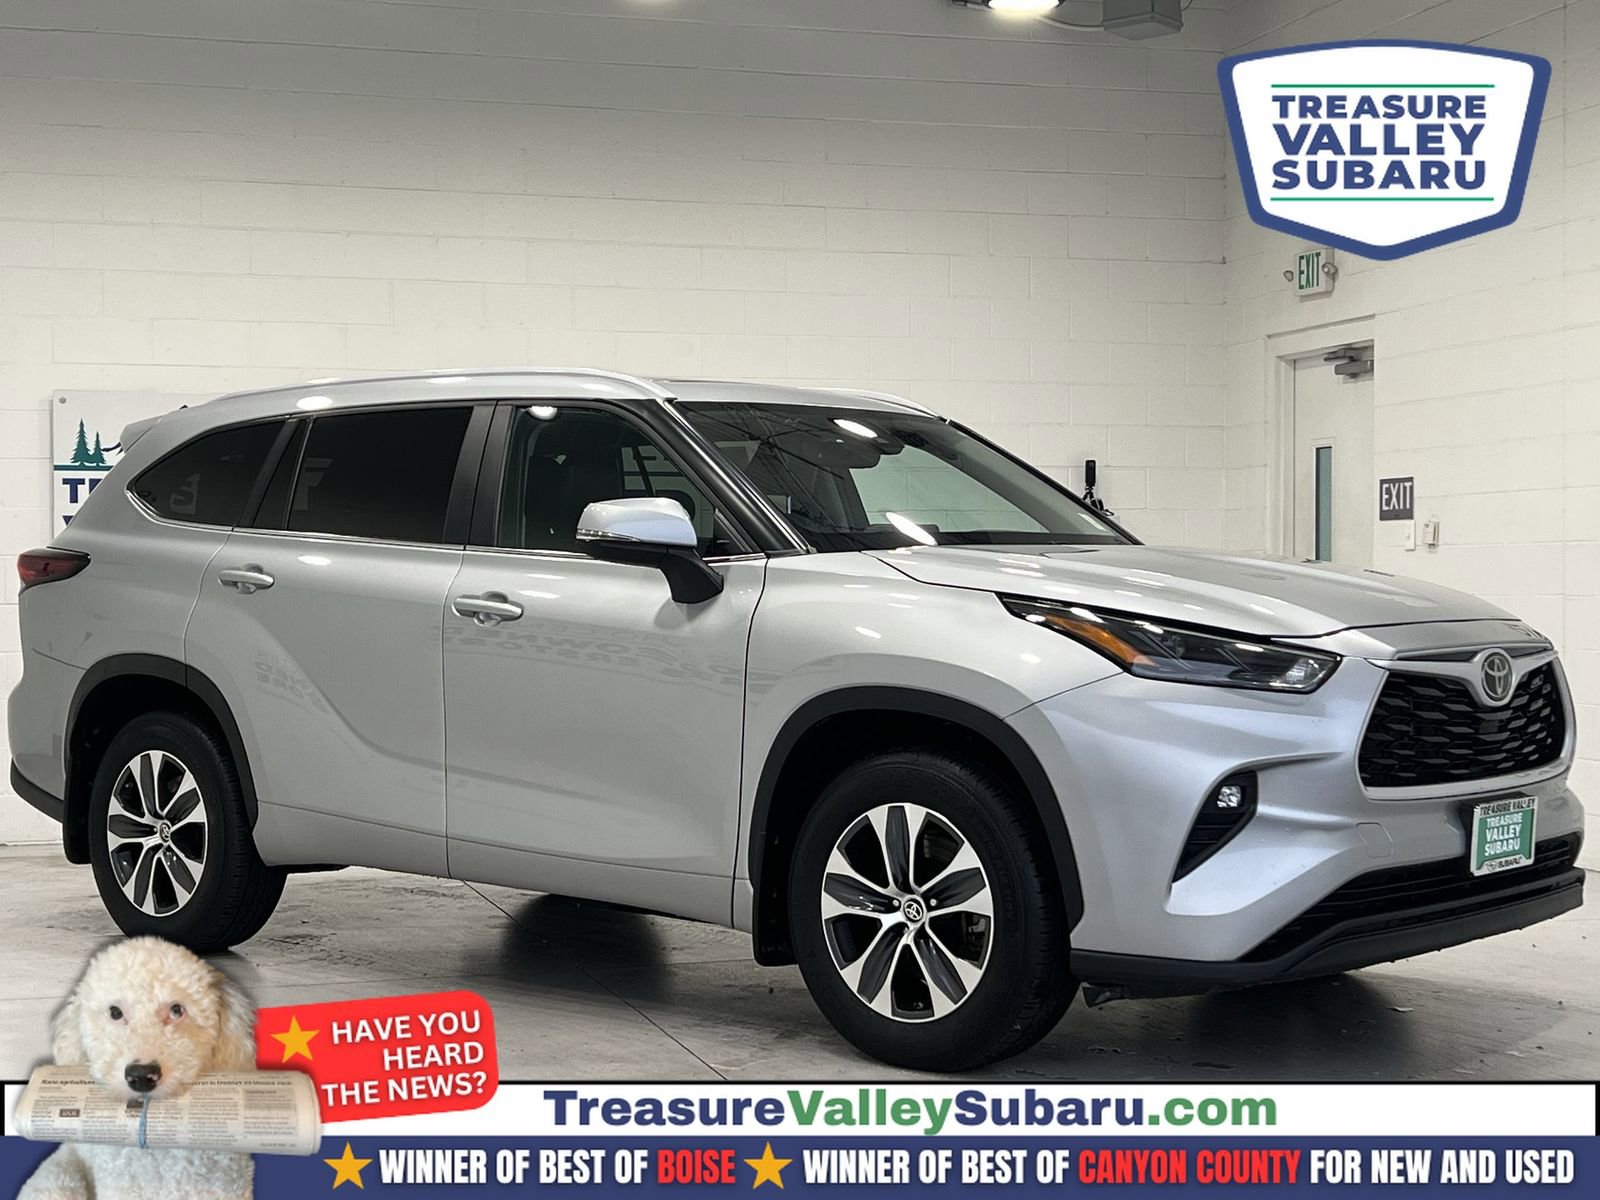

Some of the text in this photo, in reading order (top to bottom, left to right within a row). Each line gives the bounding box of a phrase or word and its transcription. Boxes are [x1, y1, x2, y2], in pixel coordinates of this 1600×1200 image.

[1298, 251, 1321, 290] EXIT
[1382, 481, 1413, 511] EXIT
[1480, 802, 1511, 816] TREASURE
[1486, 812, 1523, 828] TREASURE
[1486, 824, 1522, 842] VALLEY
[1484, 838, 1521, 857] SUBARU
